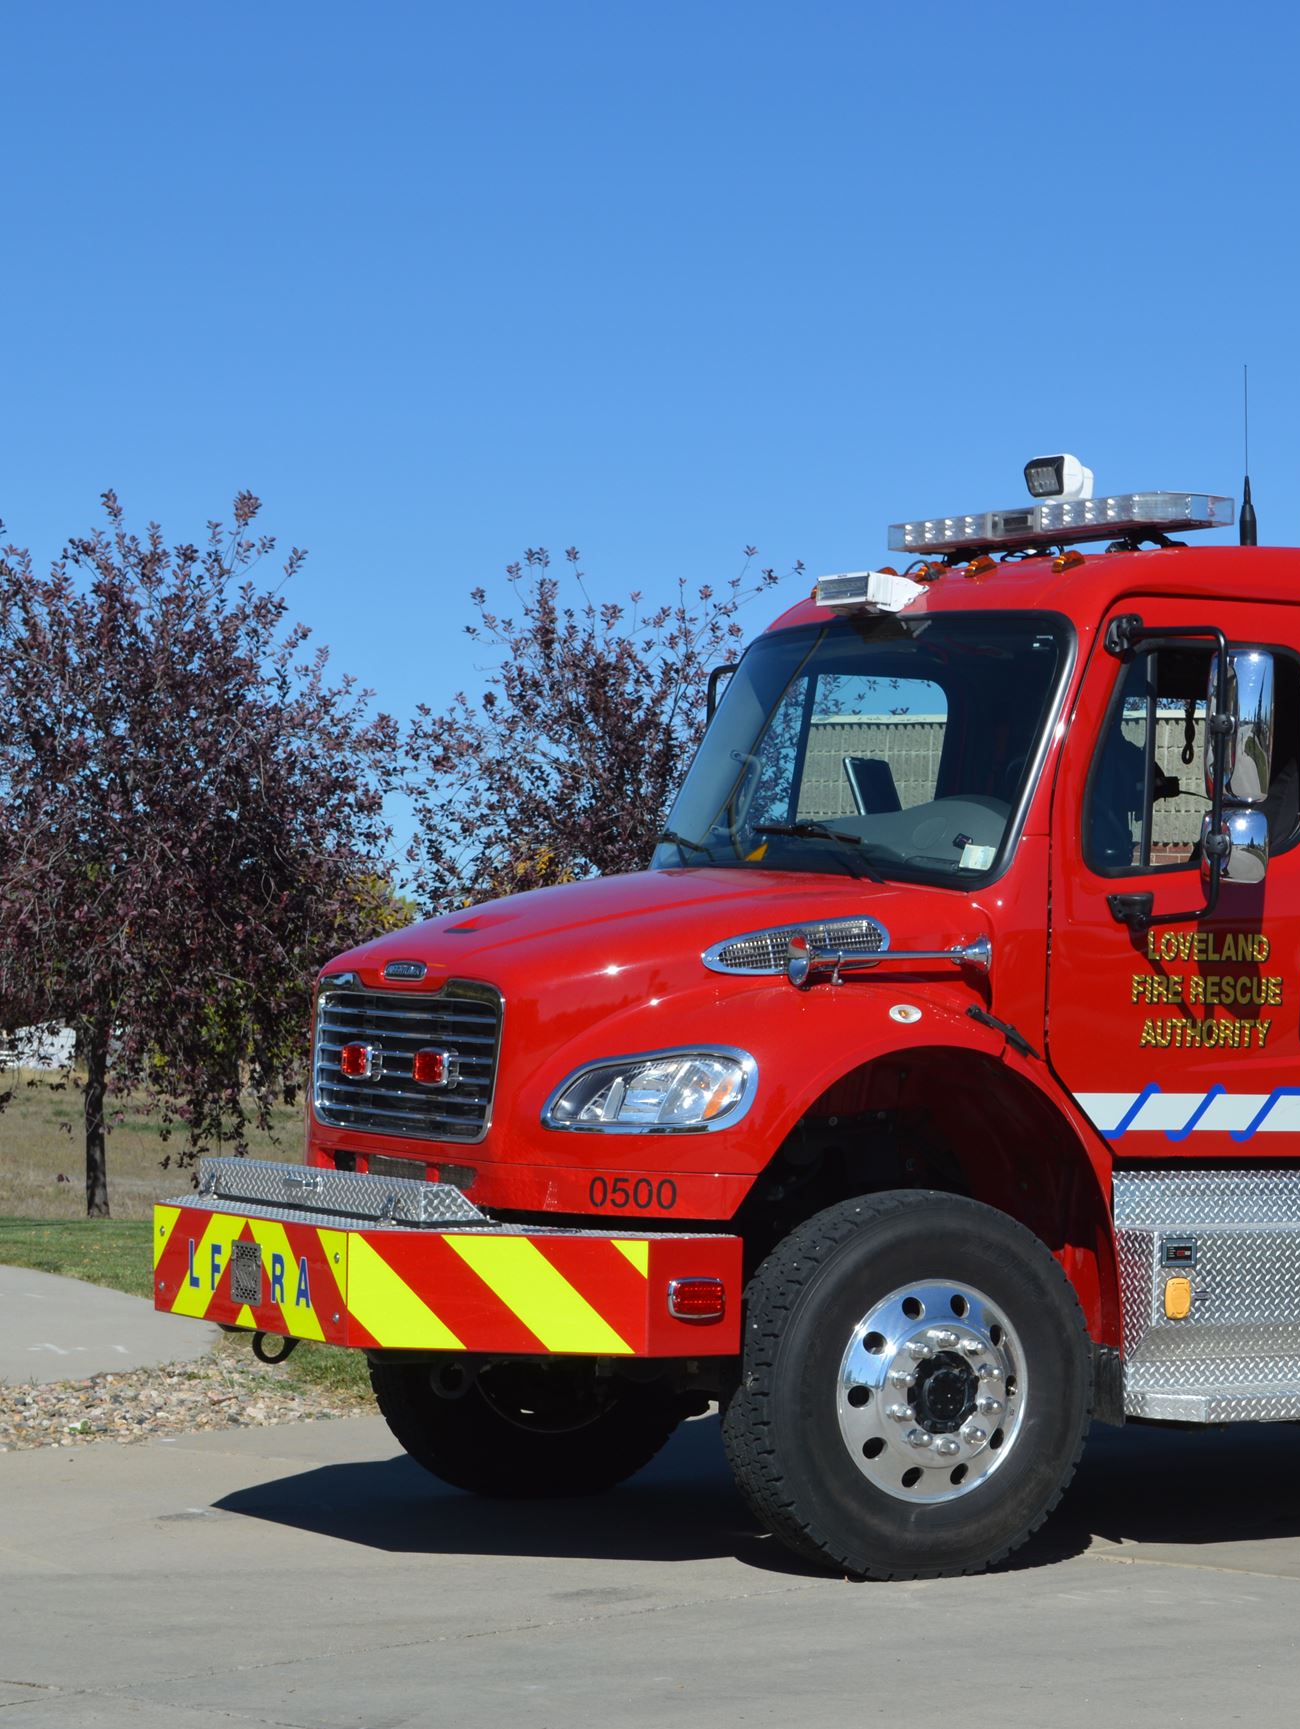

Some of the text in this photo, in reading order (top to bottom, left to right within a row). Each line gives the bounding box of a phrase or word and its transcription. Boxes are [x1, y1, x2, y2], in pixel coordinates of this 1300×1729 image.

[1147, 931, 1270, 962] LOVELAND
[1131, 974, 1283, 1006] FIRE RESCUE
[1138, 1018, 1272, 1048] AUTHORITY
[589, 1175, 677, 1210] 0500
